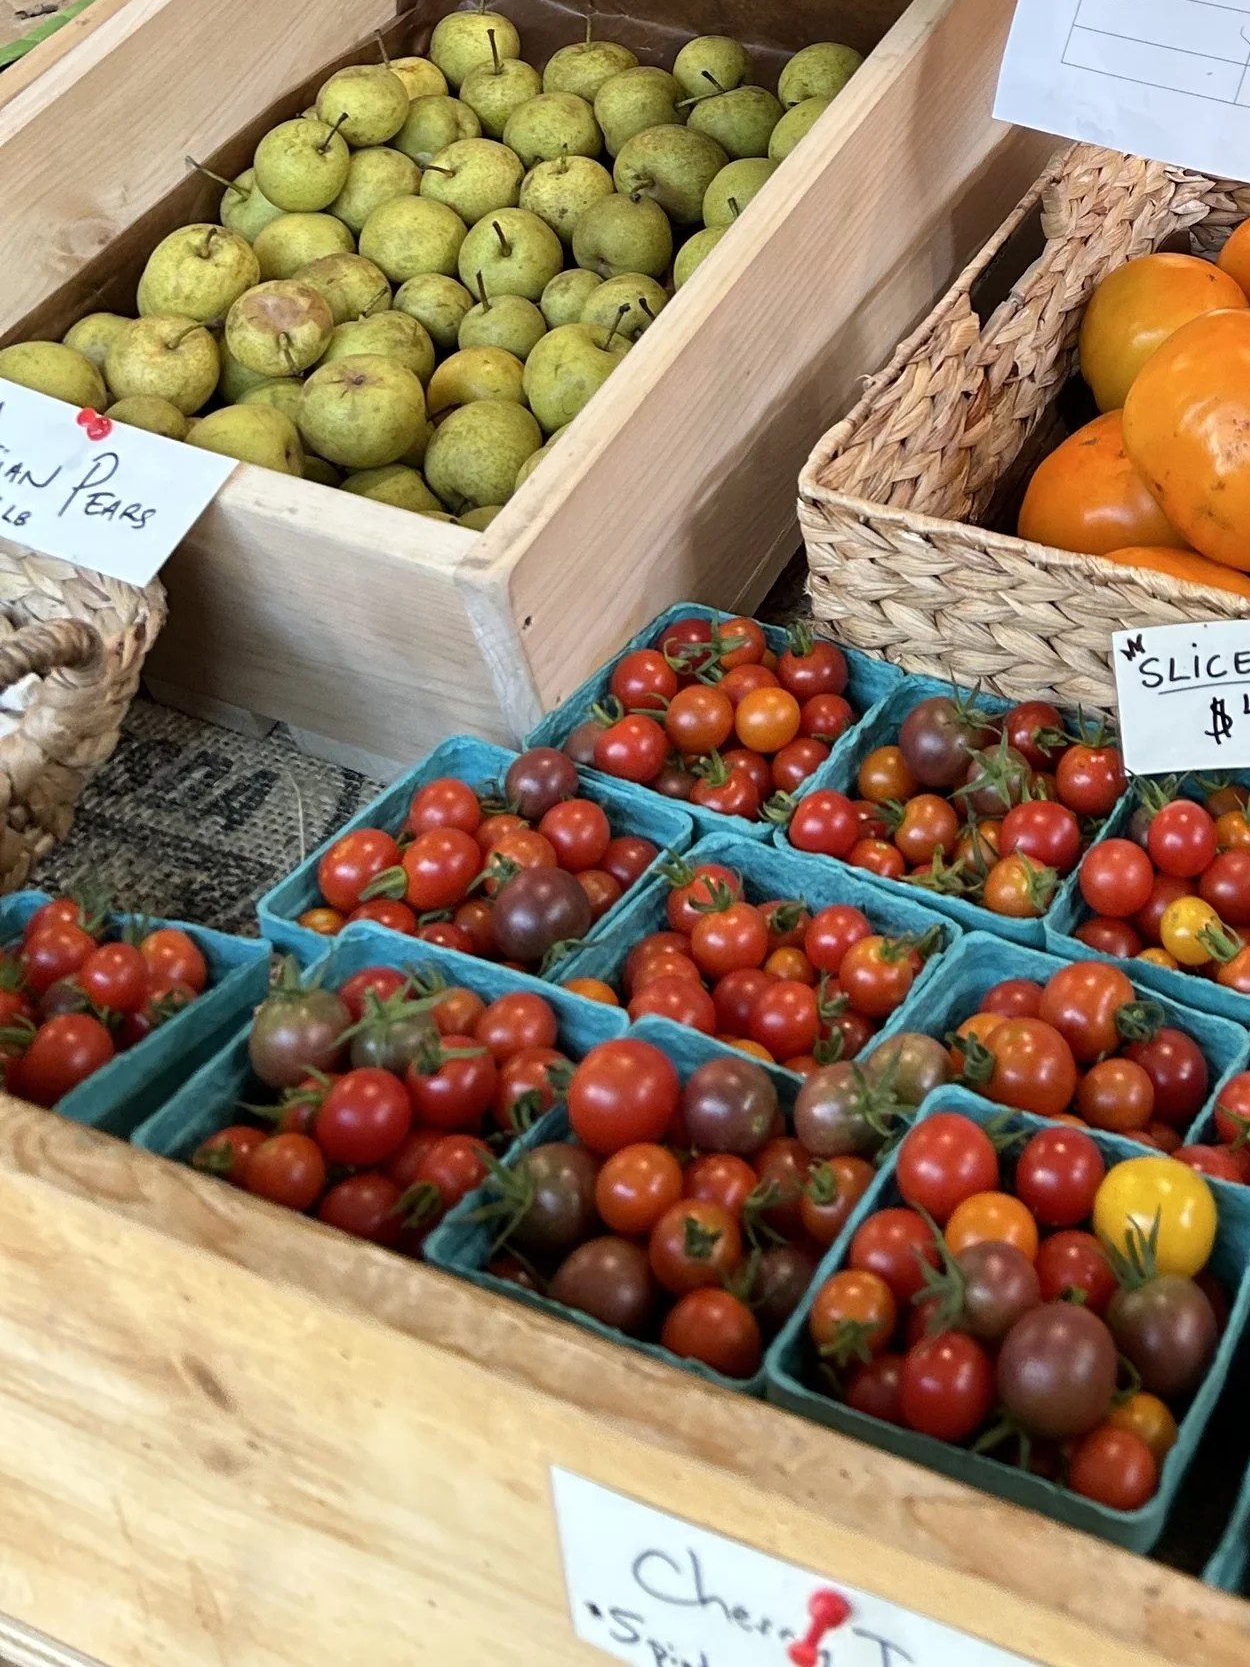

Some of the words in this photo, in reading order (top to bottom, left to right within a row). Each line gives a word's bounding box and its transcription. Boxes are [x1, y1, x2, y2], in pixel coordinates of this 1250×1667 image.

[0, 462, 62, 488] AN
[58, 452, 157, 529] PEARS
[630, 1547, 830, 1667] Cherr
[852, 1627, 915, 1667] T
